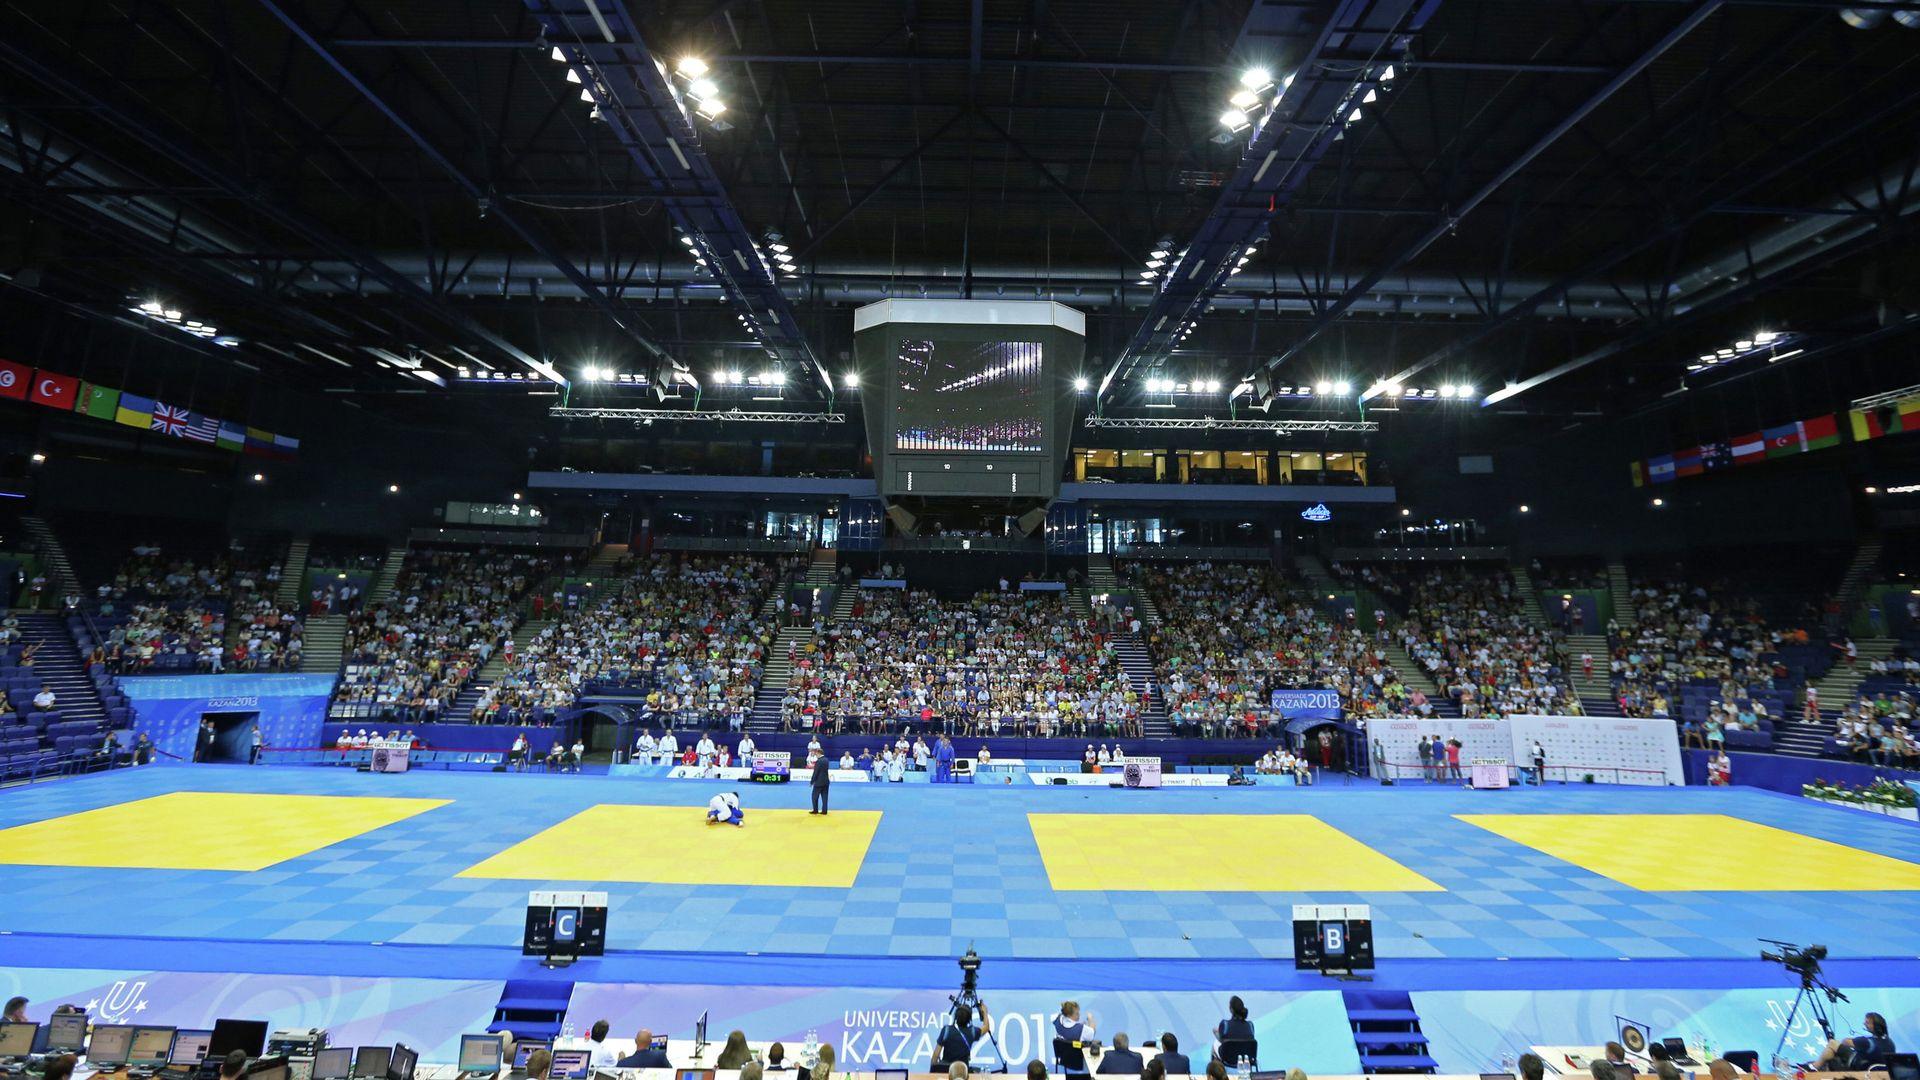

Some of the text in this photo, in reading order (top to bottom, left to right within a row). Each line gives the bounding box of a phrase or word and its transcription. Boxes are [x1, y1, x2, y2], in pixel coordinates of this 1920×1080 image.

[233, 696, 258, 707] 2013
[1272, 693, 1341, 709] KAZAN 2013
[763, 774, 781, 782] 0:31
[558, 914, 574, 936] C
[1326, 927, 1342, 950] B
[844, 1010, 953, 1029] UNIVERSIAD
[840, 1012, 1062, 1066] KAZA 201
